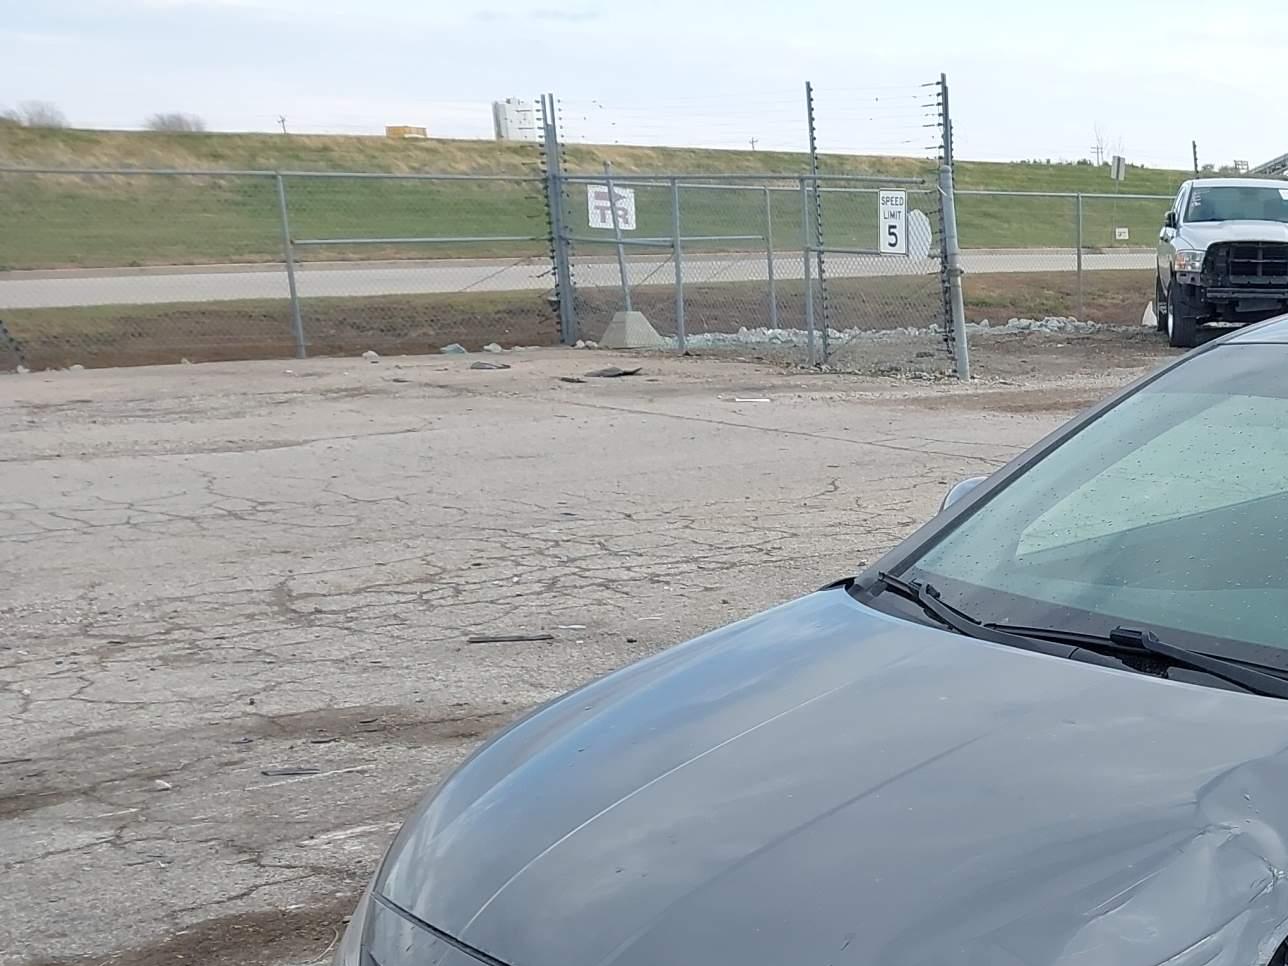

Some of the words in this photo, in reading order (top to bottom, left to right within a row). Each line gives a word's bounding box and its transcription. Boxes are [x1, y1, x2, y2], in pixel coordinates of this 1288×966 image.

[881, 196, 904, 206] SPEED
[883, 210, 902, 220] LIMIT
[887, 224, 898, 247] 5
